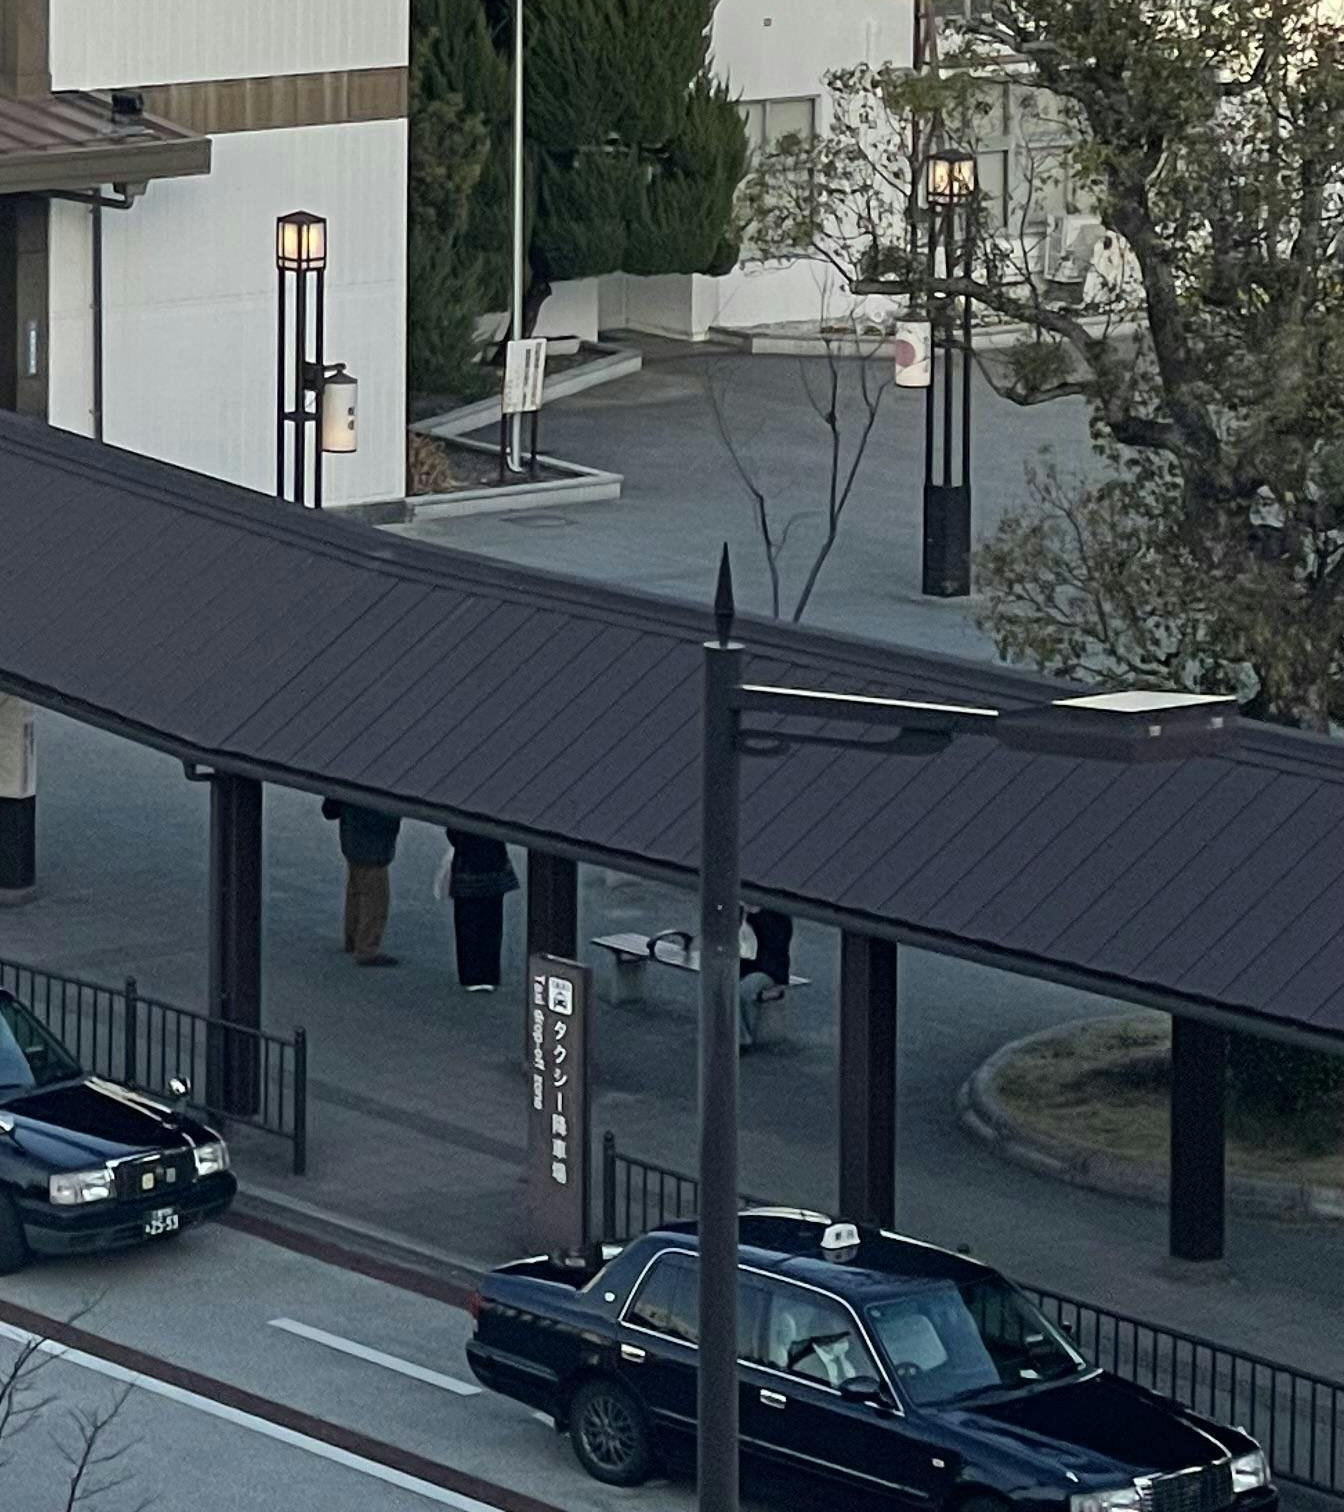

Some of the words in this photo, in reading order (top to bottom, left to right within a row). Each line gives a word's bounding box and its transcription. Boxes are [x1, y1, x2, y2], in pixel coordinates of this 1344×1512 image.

[533, 975, 546, 1006] Taxi
[533, 1009, 546, 1072] drop-off
[533, 1074, 545, 1110] zone
